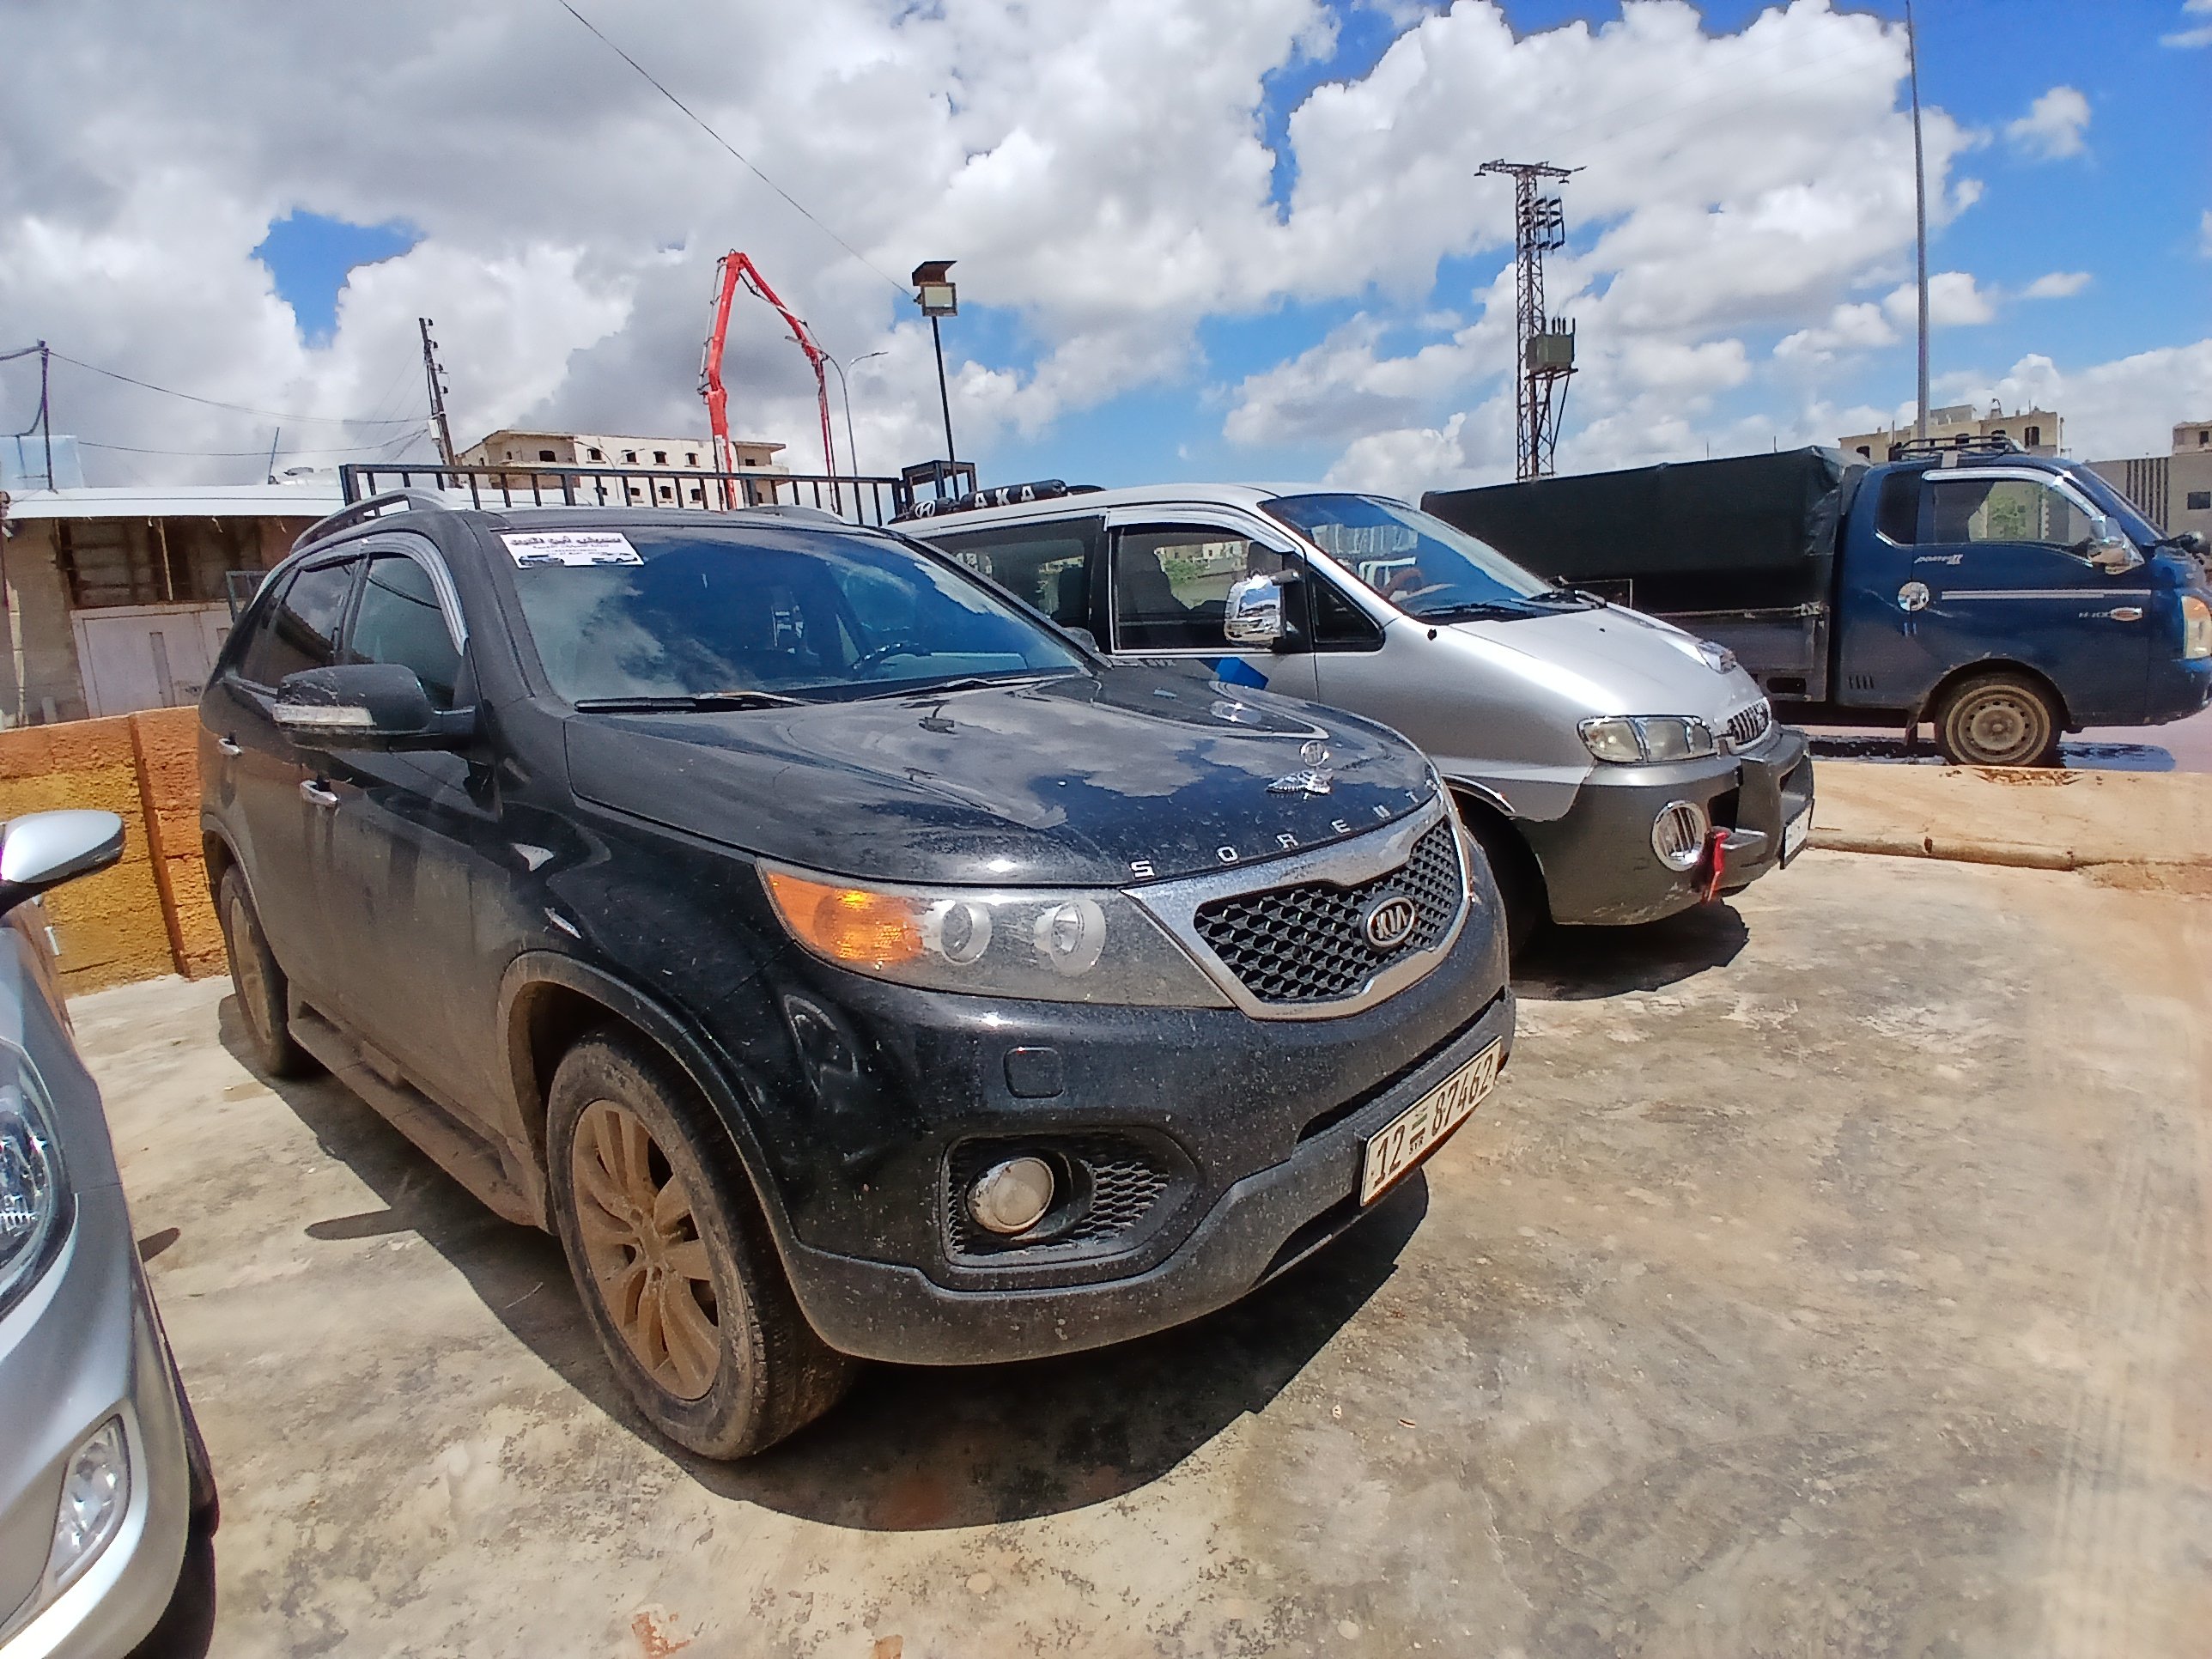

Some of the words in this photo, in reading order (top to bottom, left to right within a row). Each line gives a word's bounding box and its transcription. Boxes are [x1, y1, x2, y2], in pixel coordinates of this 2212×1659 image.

[1130, 779, 1437, 879] SORENTO
[1375, 904, 1408, 939] KIA
[1373, 1124, 1406, 1190] 12
[1431, 1053, 1493, 1138] 87462
